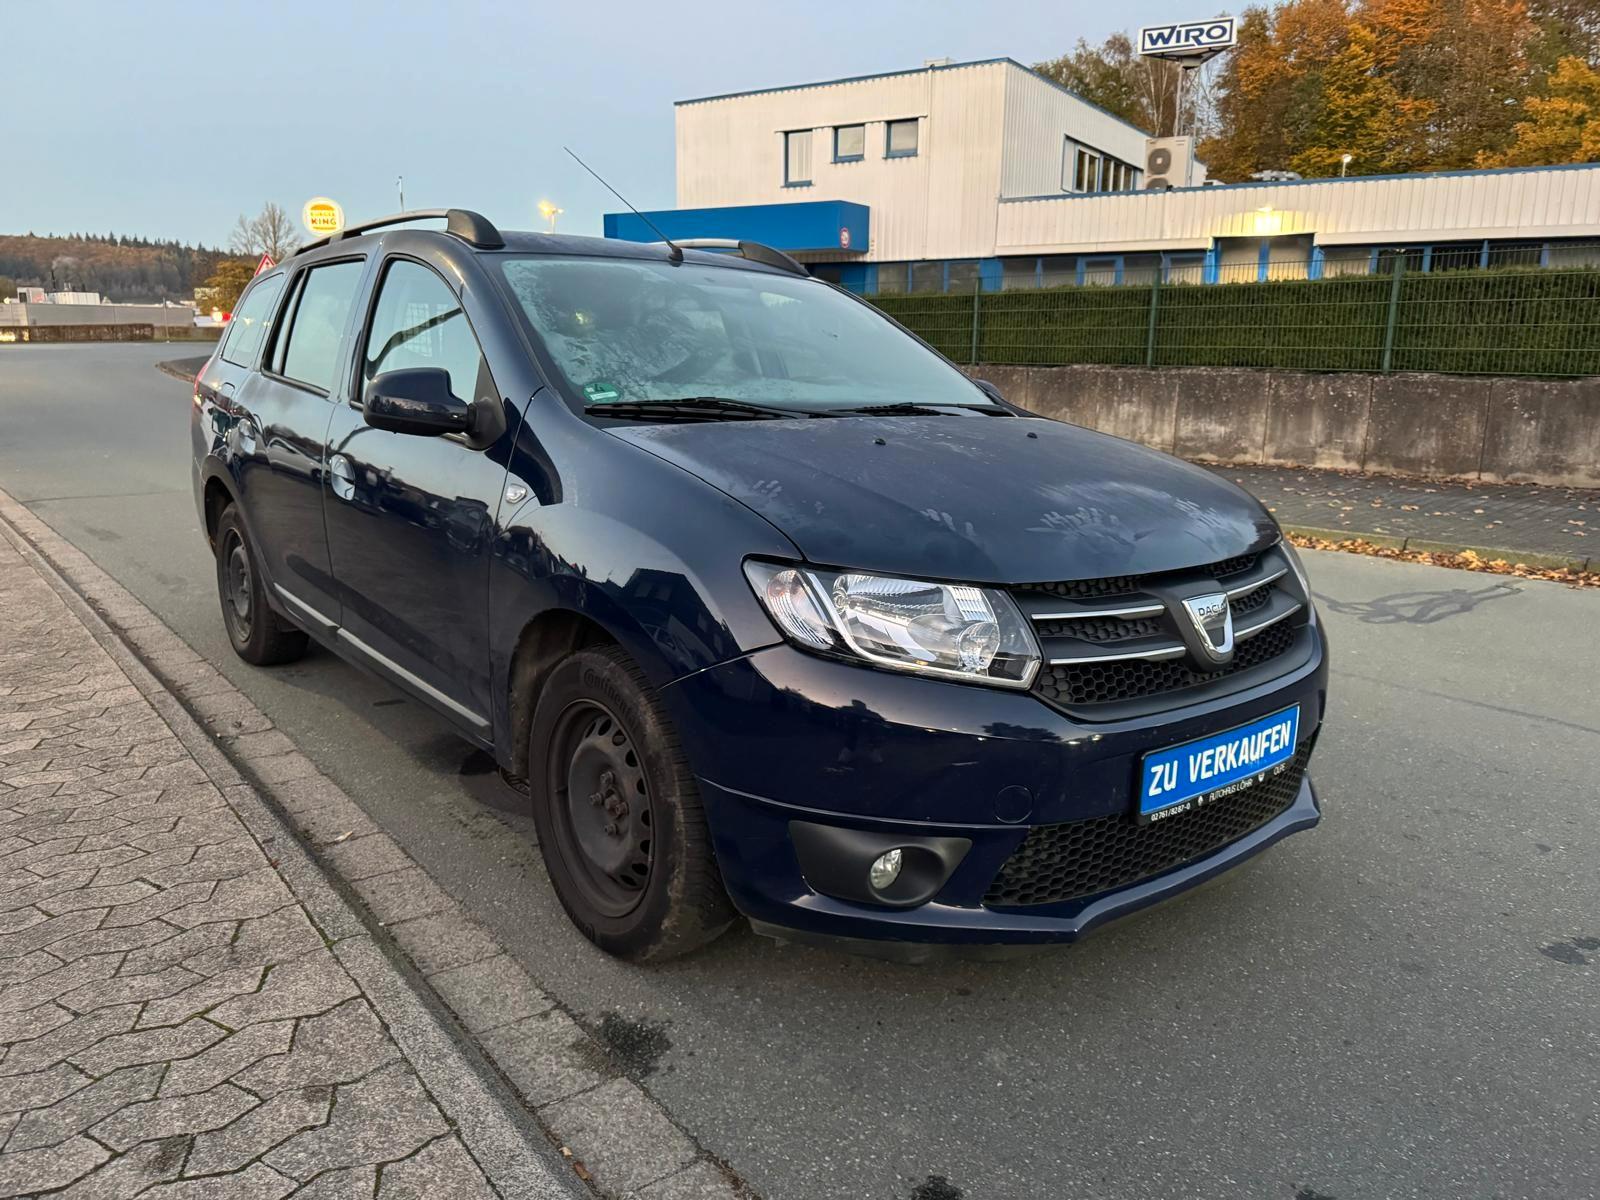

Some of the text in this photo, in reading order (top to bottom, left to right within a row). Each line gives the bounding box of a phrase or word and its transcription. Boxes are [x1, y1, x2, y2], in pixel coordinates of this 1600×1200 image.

[1147, 24, 1228, 46] WIRO
[311, 218, 337, 226] KING
[1198, 603, 1225, 616] DACIA
[1148, 720, 1291, 797] ZU VERKAUFEN
[1209, 784, 1236, 803] AUTOHAUS
